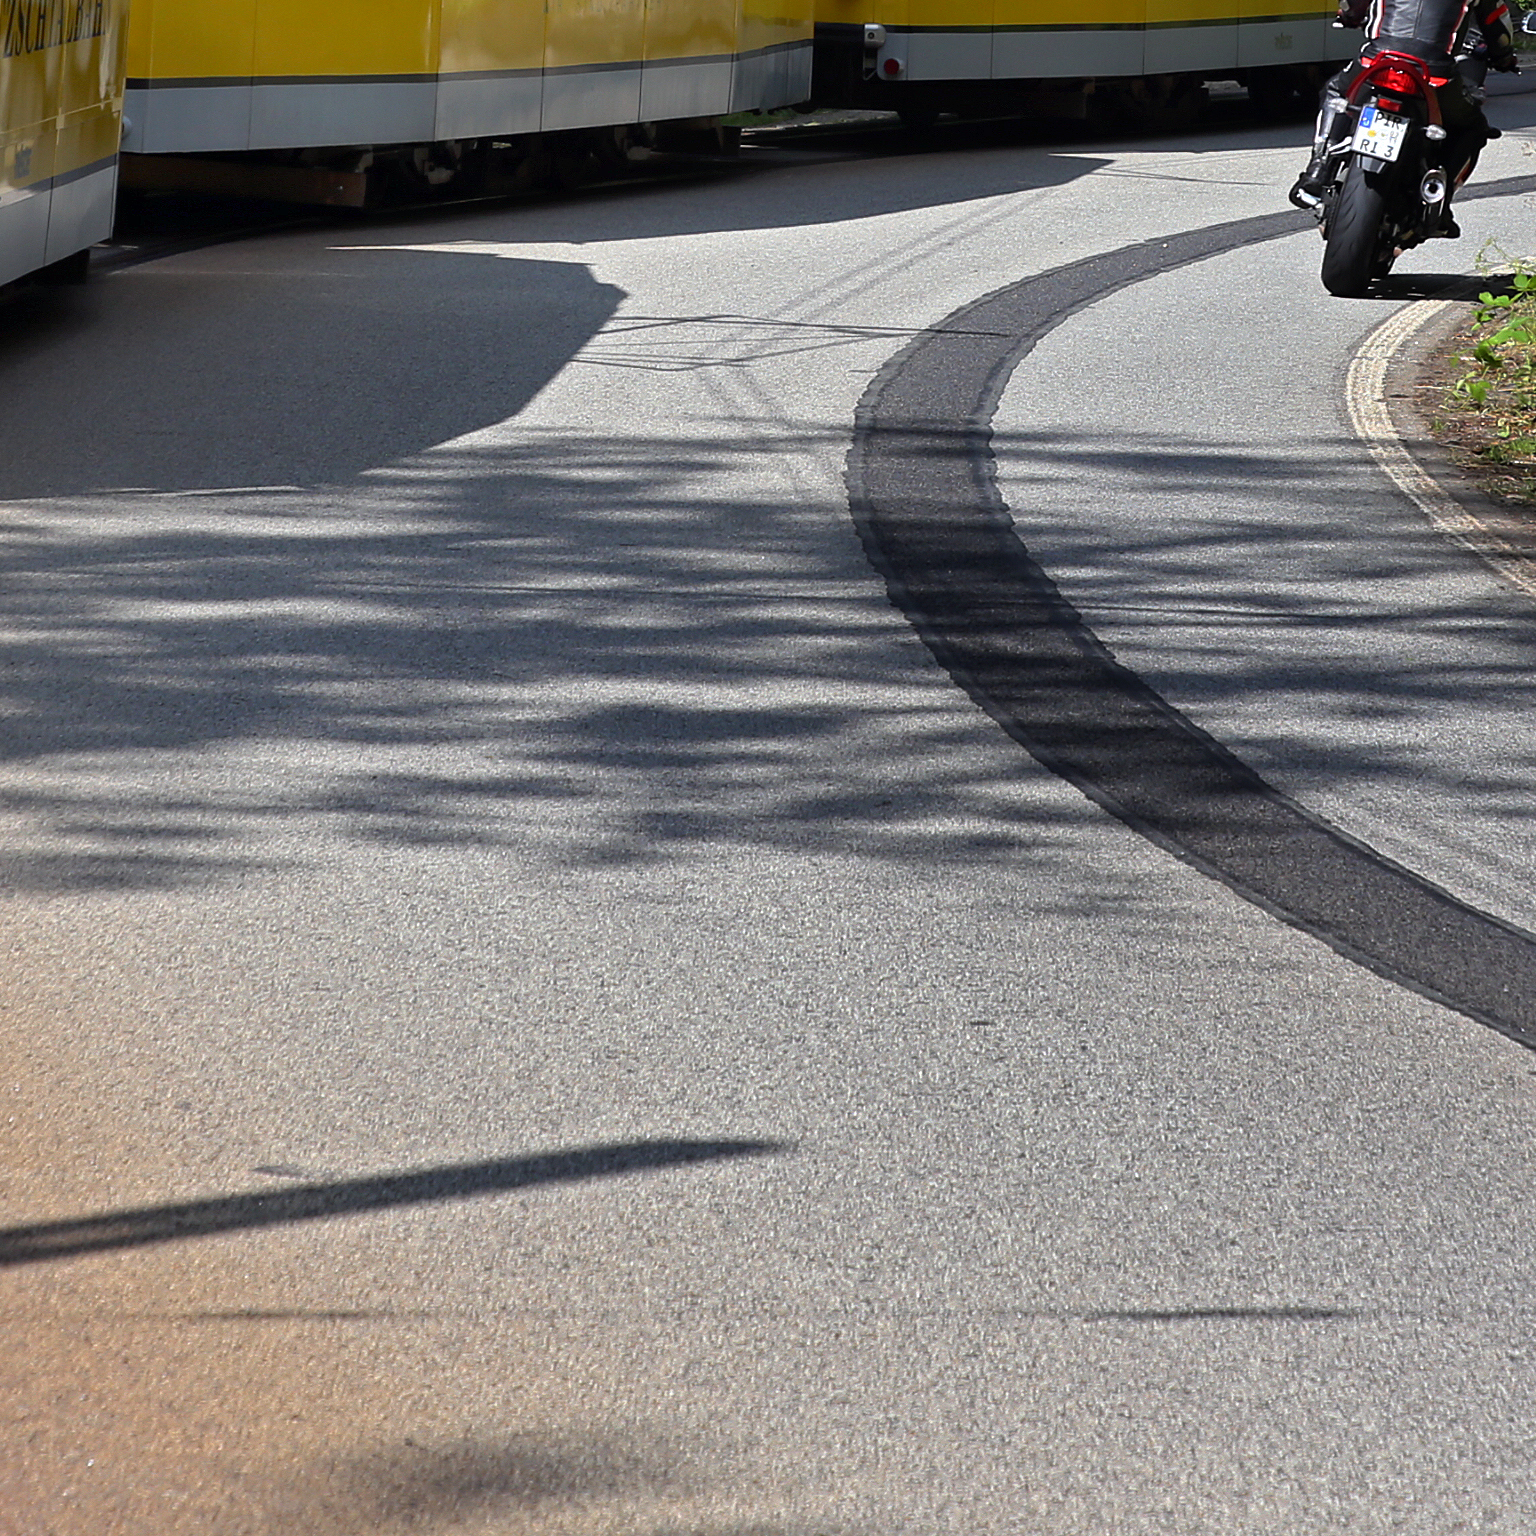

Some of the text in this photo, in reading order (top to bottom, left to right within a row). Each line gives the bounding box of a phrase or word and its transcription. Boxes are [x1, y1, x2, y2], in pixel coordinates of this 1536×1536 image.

[1375, 111, 1401, 130] PIR
[1360, 138, 1394, 158] RI 3
